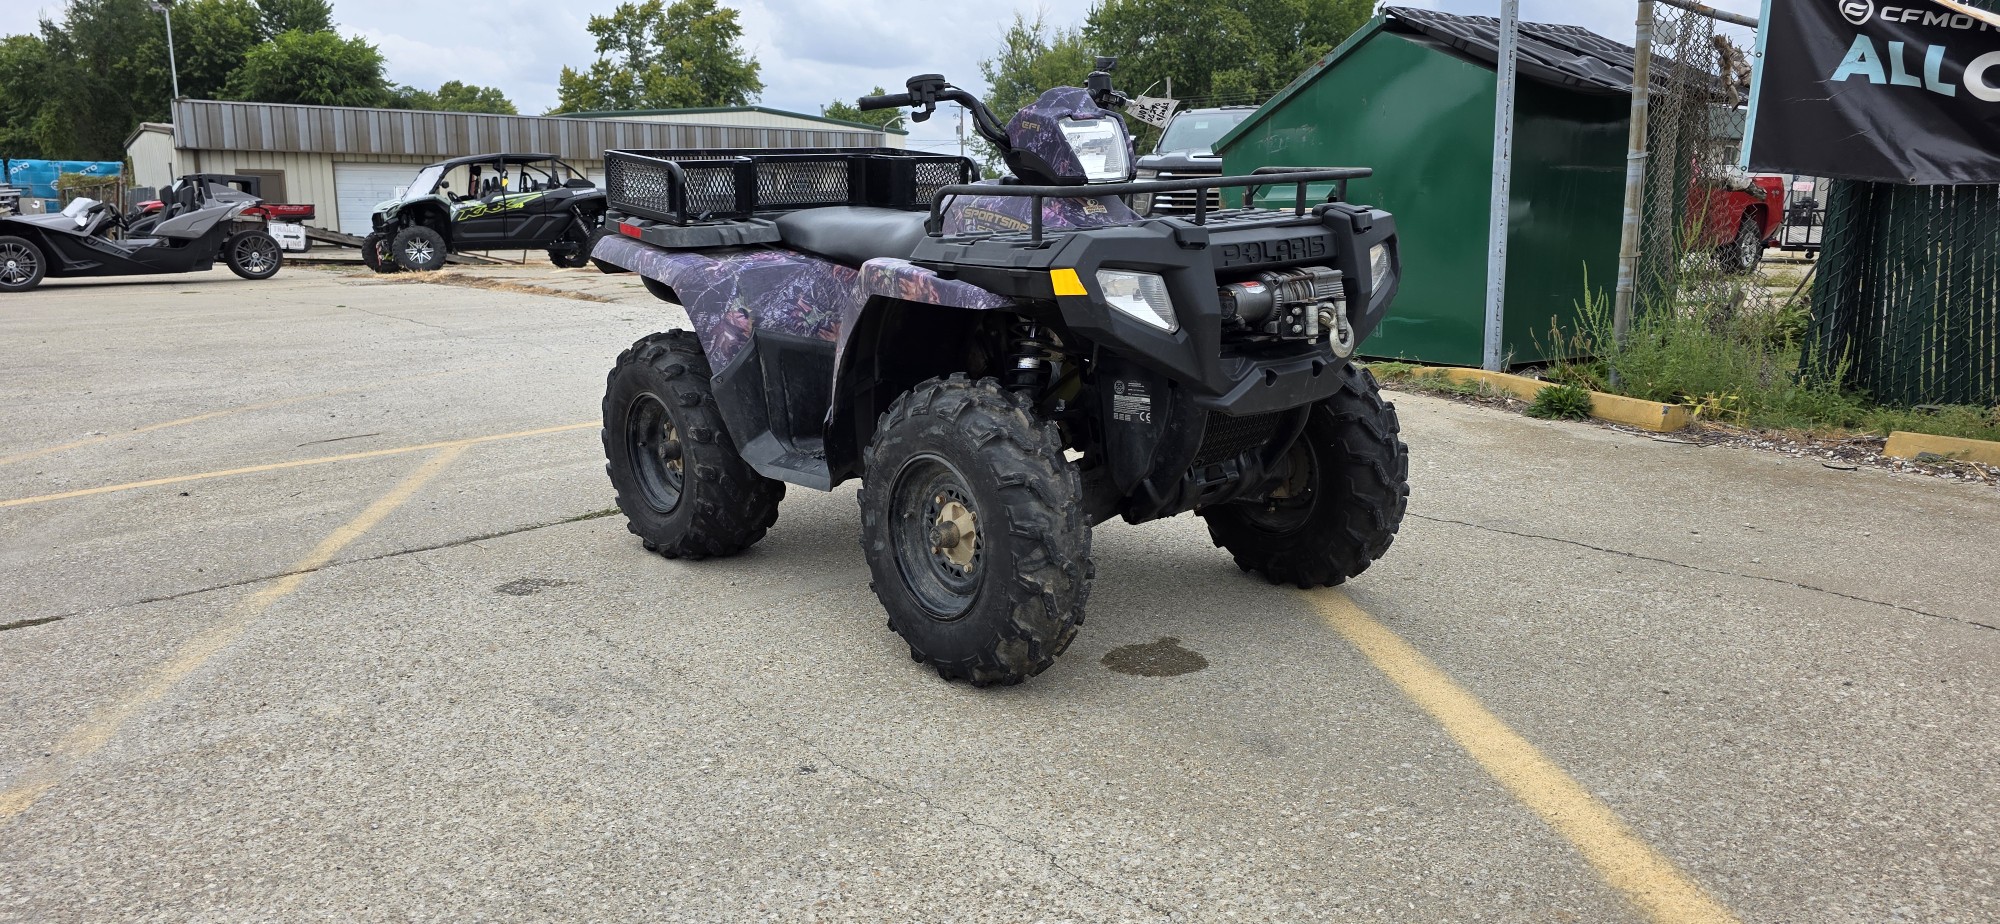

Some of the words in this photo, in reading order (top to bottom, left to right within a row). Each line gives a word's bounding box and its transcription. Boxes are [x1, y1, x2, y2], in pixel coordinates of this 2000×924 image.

[1880, 6, 2000, 32] CFMO
[1830, 33, 1956, 97] ALL
[1022, 121, 1040, 132] EFI
[273, 226, 302, 234] TRAILER
[1220, 235, 1326, 267] POLARIS
